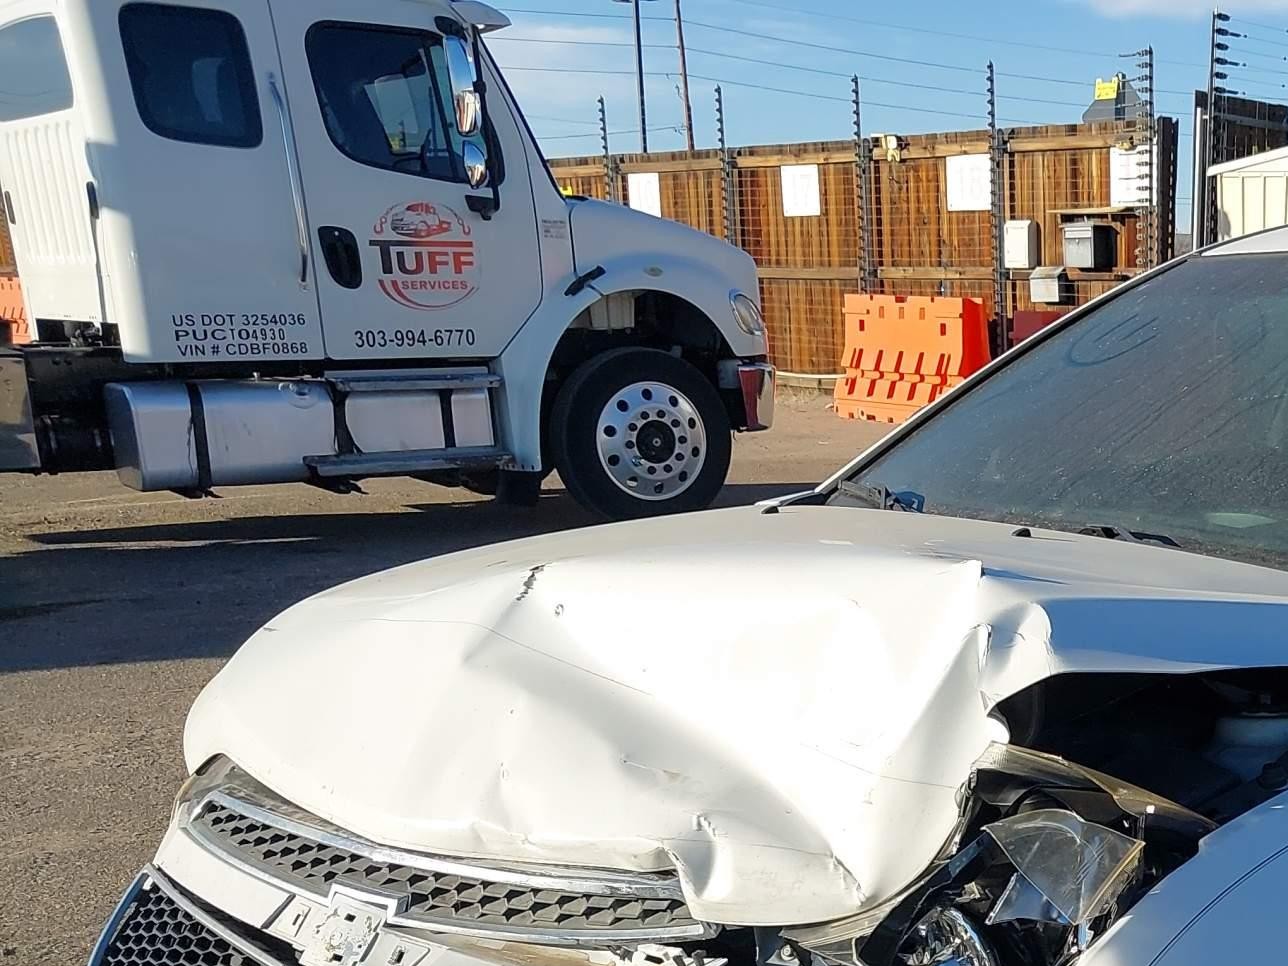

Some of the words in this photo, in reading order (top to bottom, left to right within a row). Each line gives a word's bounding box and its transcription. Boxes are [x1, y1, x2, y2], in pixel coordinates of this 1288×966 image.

[369, 239, 474, 275] TUFF
[401, 280, 468, 290] SERVICES
[172, 314, 196, 327] US
[201, 314, 236, 326] DOT
[241, 313, 306, 326] 3254036
[354, 328, 475, 348] 303-994-6770
[176, 344, 206, 356] VIN
[210, 343, 221, 356] #
[225, 342, 308, 355] CDBF0868
